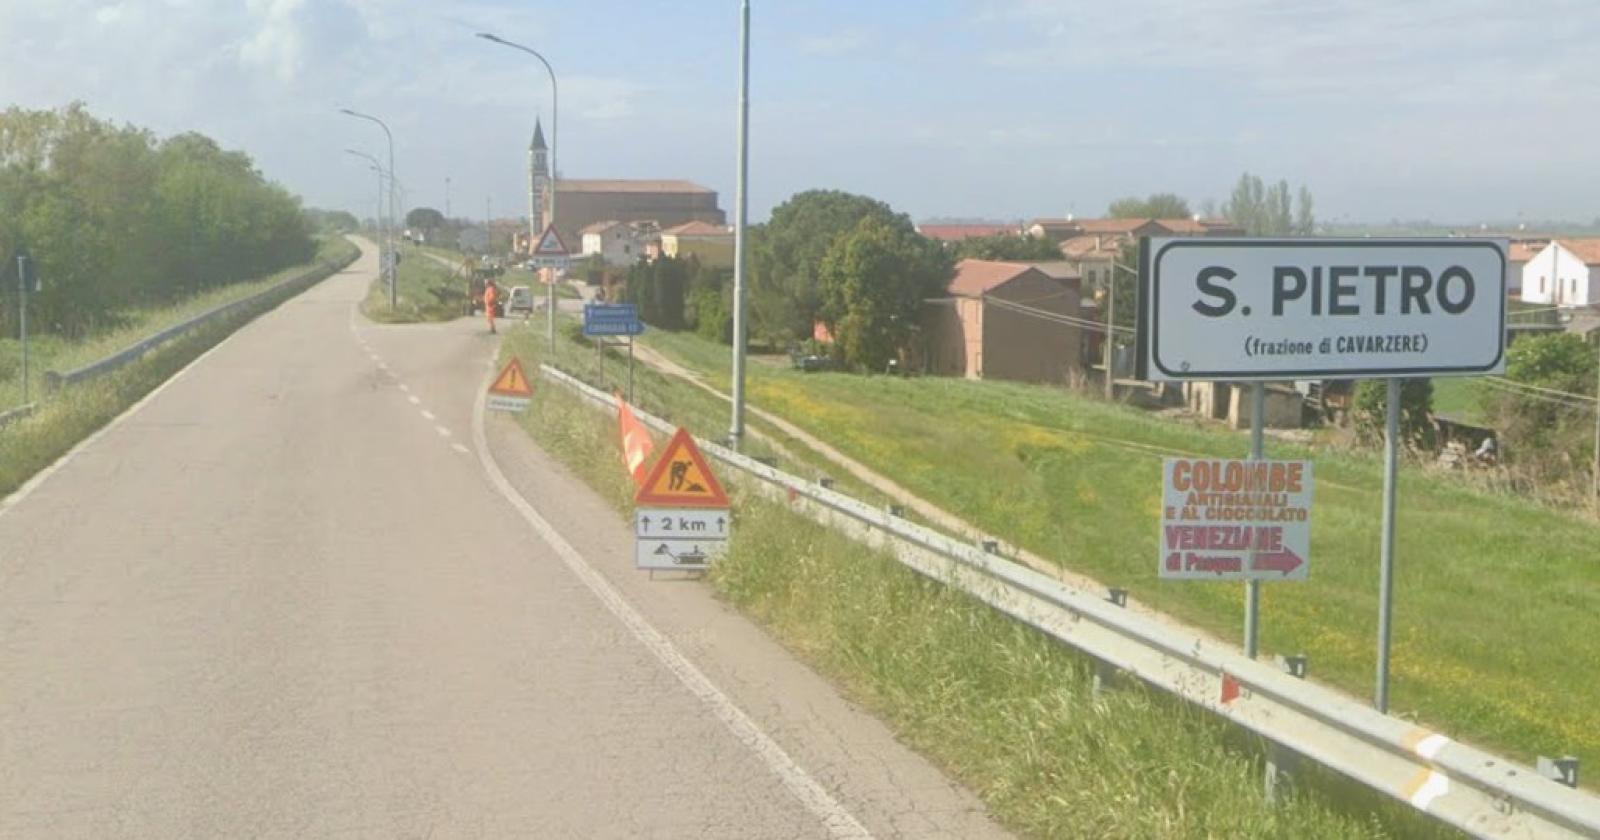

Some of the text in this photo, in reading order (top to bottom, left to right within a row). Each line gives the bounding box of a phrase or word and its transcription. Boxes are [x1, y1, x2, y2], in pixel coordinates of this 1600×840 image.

[1192, 265, 1476, 318] S. PIETRO
[1244, 334, 1429, 357] (frazione di CAVARZERE)
[1172, 460, 1304, 493] COLOMBE
[661, 517, 706, 531] 2 km
[1165, 506, 1307, 522] E AL CIOCCOLATO
